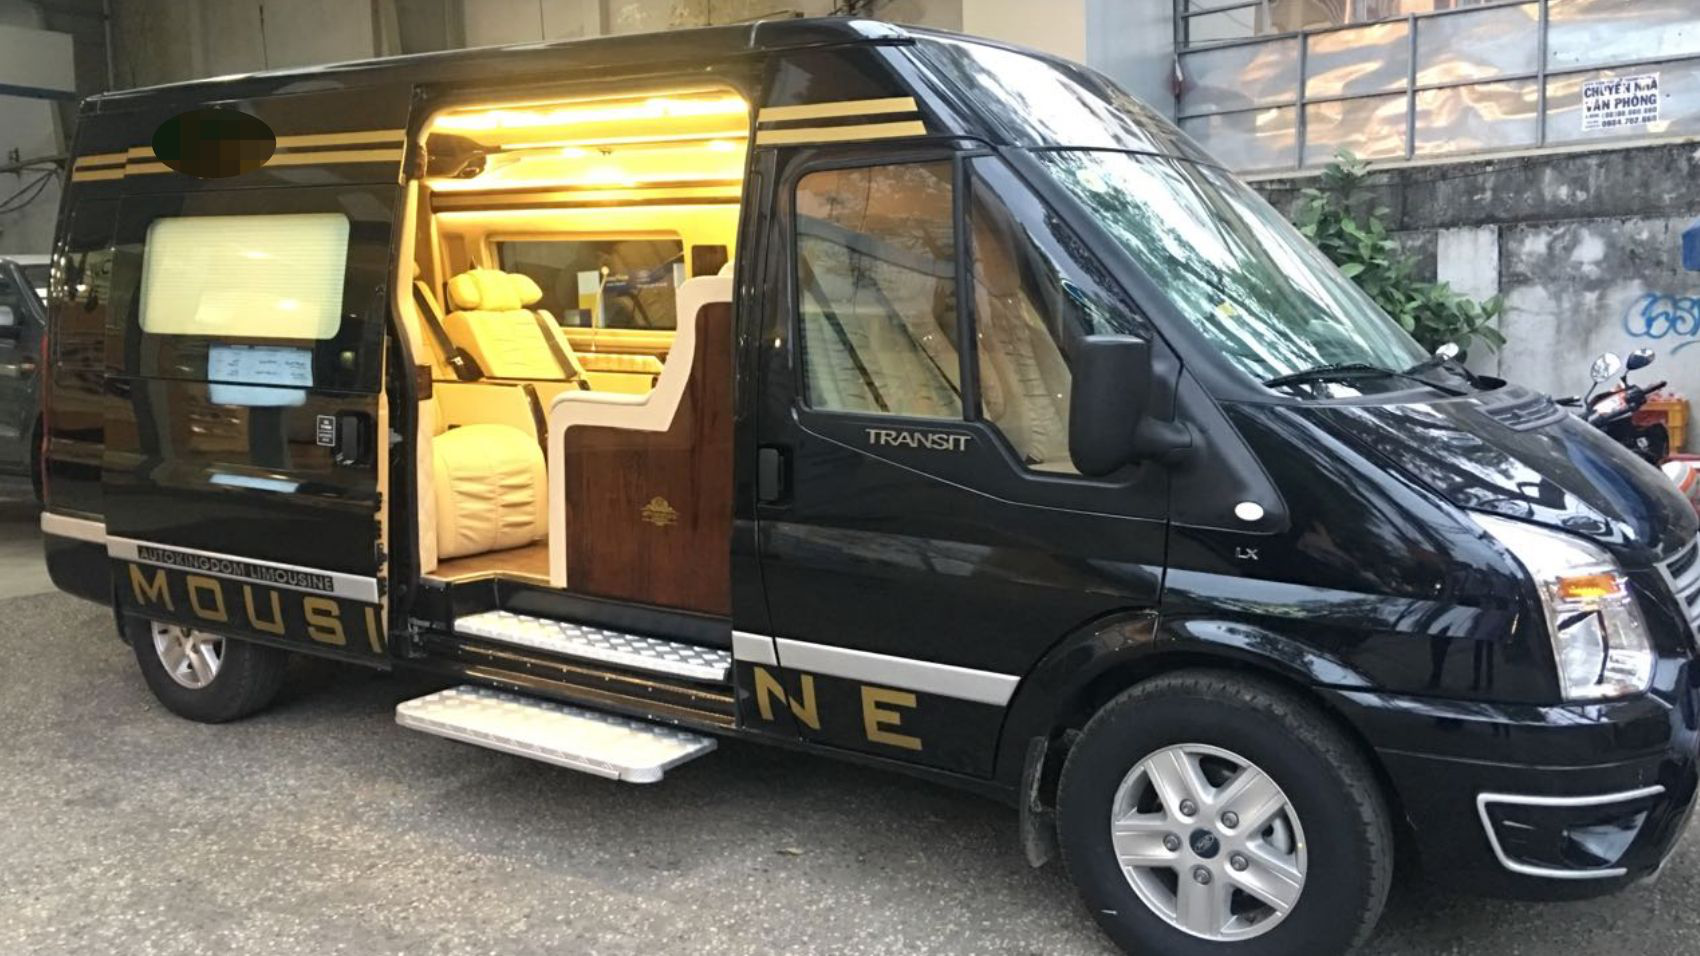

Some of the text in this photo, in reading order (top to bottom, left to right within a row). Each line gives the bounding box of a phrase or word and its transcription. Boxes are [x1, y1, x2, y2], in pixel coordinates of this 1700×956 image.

[865, 429, 971, 451] TRANSIT
[140, 547, 334, 592] AUTOKINGDOM LIMOUSINE
[1235, 546, 1259, 560] LX
[753, 666, 923, 750] NE
